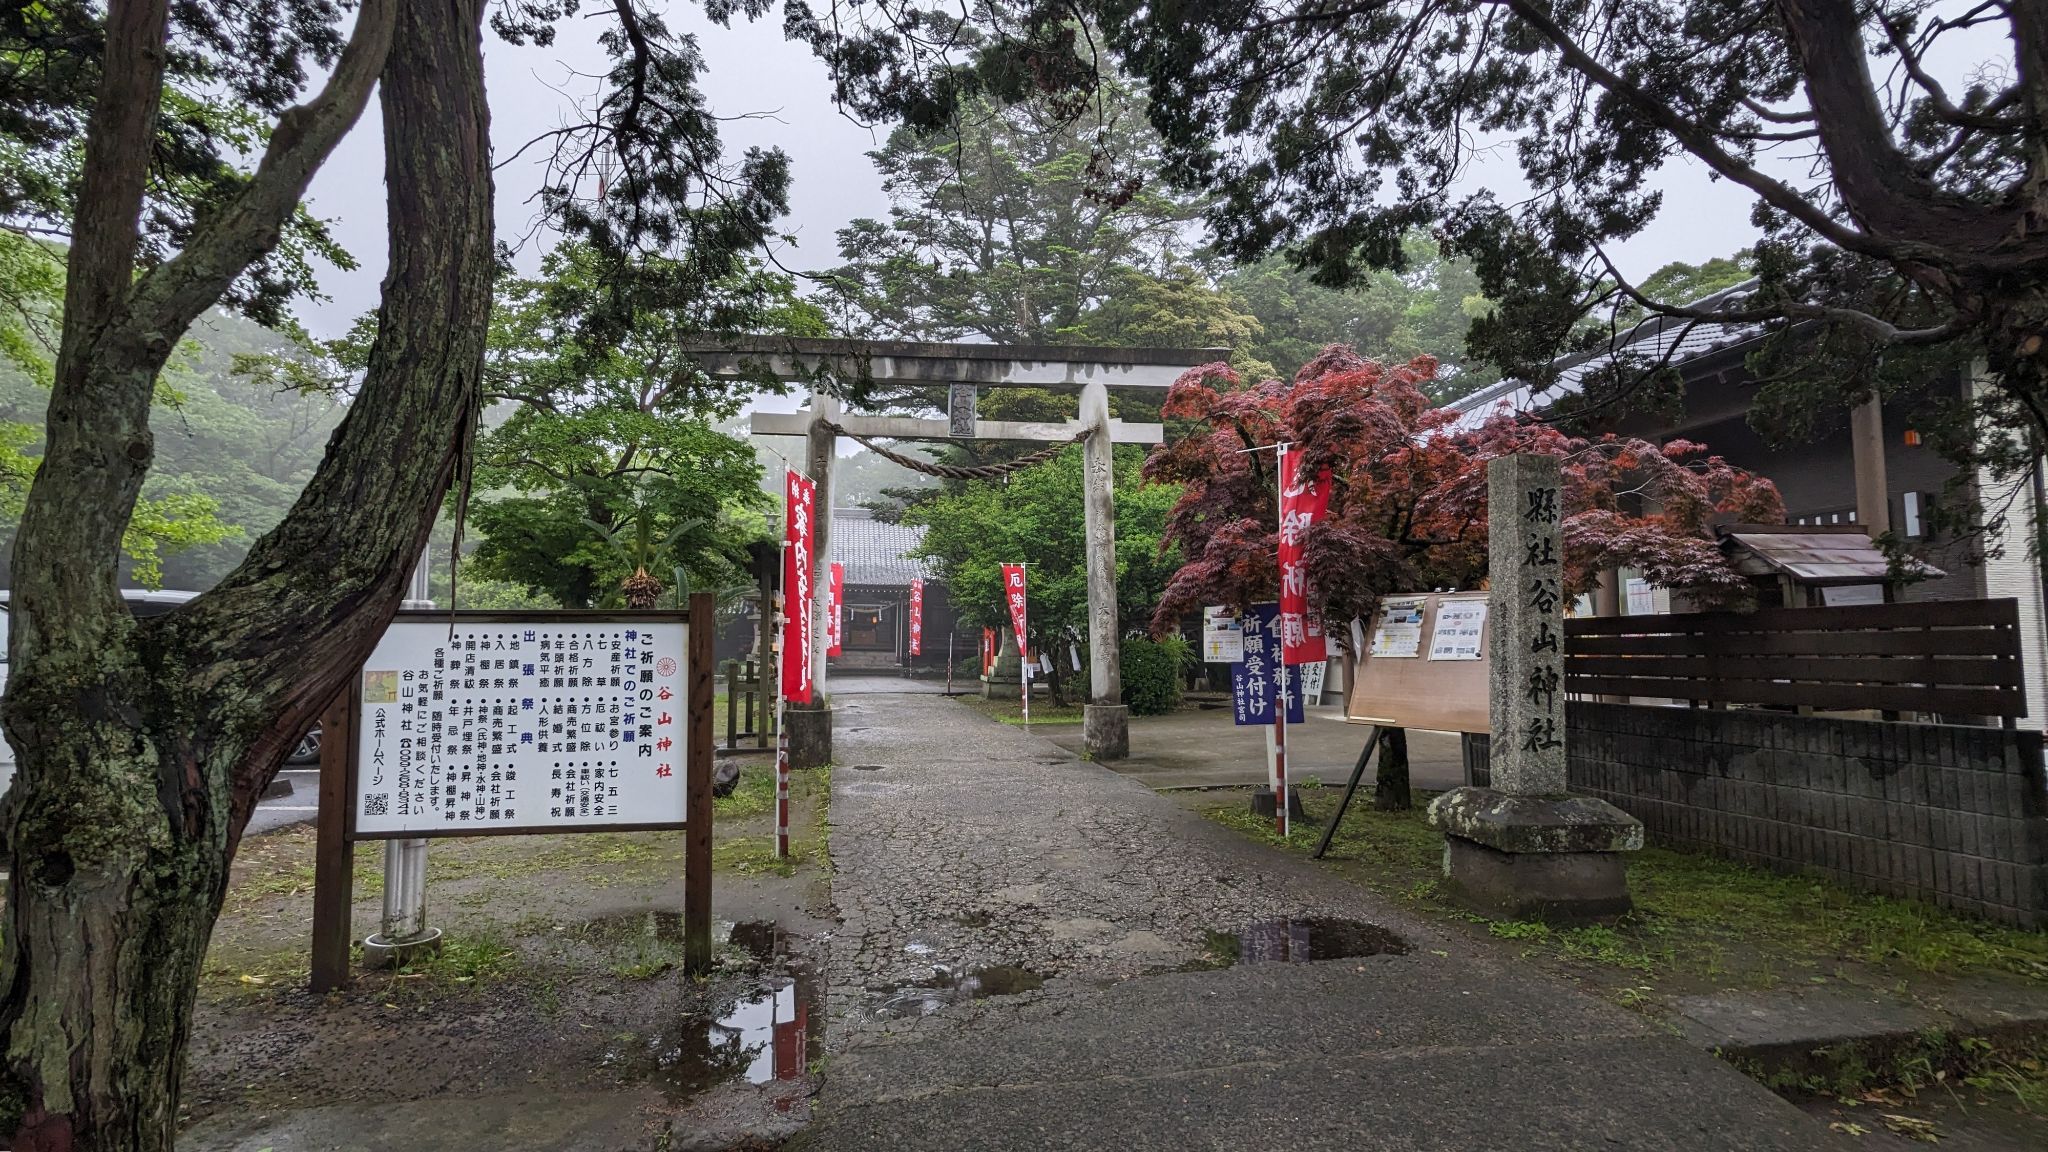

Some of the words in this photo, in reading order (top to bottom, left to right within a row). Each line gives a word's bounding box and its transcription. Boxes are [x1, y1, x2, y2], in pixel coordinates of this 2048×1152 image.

[1521, 487, 1563, 753] 縣社谷山神社
[433, 648, 444, 700] 各種ご祈願
[450, 641, 461, 689] 神葬祭
[464, 641, 476, 689] 開店清祓
[479, 641, 490, 688] 神棚祭
[494, 641, 505, 688] 入居祭
[509, 641, 519, 688] 地鎮祭
[521, 630, 535, 744] 出張祭典
[540, 640, 550, 687] 病気平癒
[554, 641, 564, 687] 年頭祈願
[568, 641, 579, 687] 合格祈願
[582, 640, 593, 686] 八方除
[597, 640, 607, 686] 七草
[610, 641, 621, 686] 安産祈願
[623, 630, 637, 742] 神社でのご祈願
[1241, 613, 1268, 717] 祈願受付け
[401, 670, 414, 730] 谷山神社
[639, 634, 653, 757] ご祈願のご案内
[373, 708, 385, 785] 公式ホームページ
[413, 670, 429, 815] お気軽にご相談ください
[447, 706, 459, 755] 年忌祭
[462, 706, 473, 754] 井戸埋祭
[492, 706, 503, 754] 商売繁盛
[507, 705, 518, 753] 起工式
[538, 705, 548, 752] 人形供養
[552, 705, 563, 752] 結婚式
[566, 704, 577, 752] 商売繁盛
[581, 704, 591, 751] 方位除
[595, 704, 605, 751] 厄祓い
[609, 704, 619, 750] お宮参り
[656, 687, 673, 778] 谷山神社
[430, 711, 442, 811] 随時受付いたします。
[445, 772, 456, 820] 神棚昇神
[460, 772, 471, 820] 昇神祭
[490, 771, 501, 819] 会社祈願
[505, 771, 516, 819] 竣工祭
[551, 769, 561, 817] 長寿祝
[565, 769, 575, 817] 会社祈願
[594, 768, 604, 815] 家内安全
[608, 768, 618, 814] 七五三
